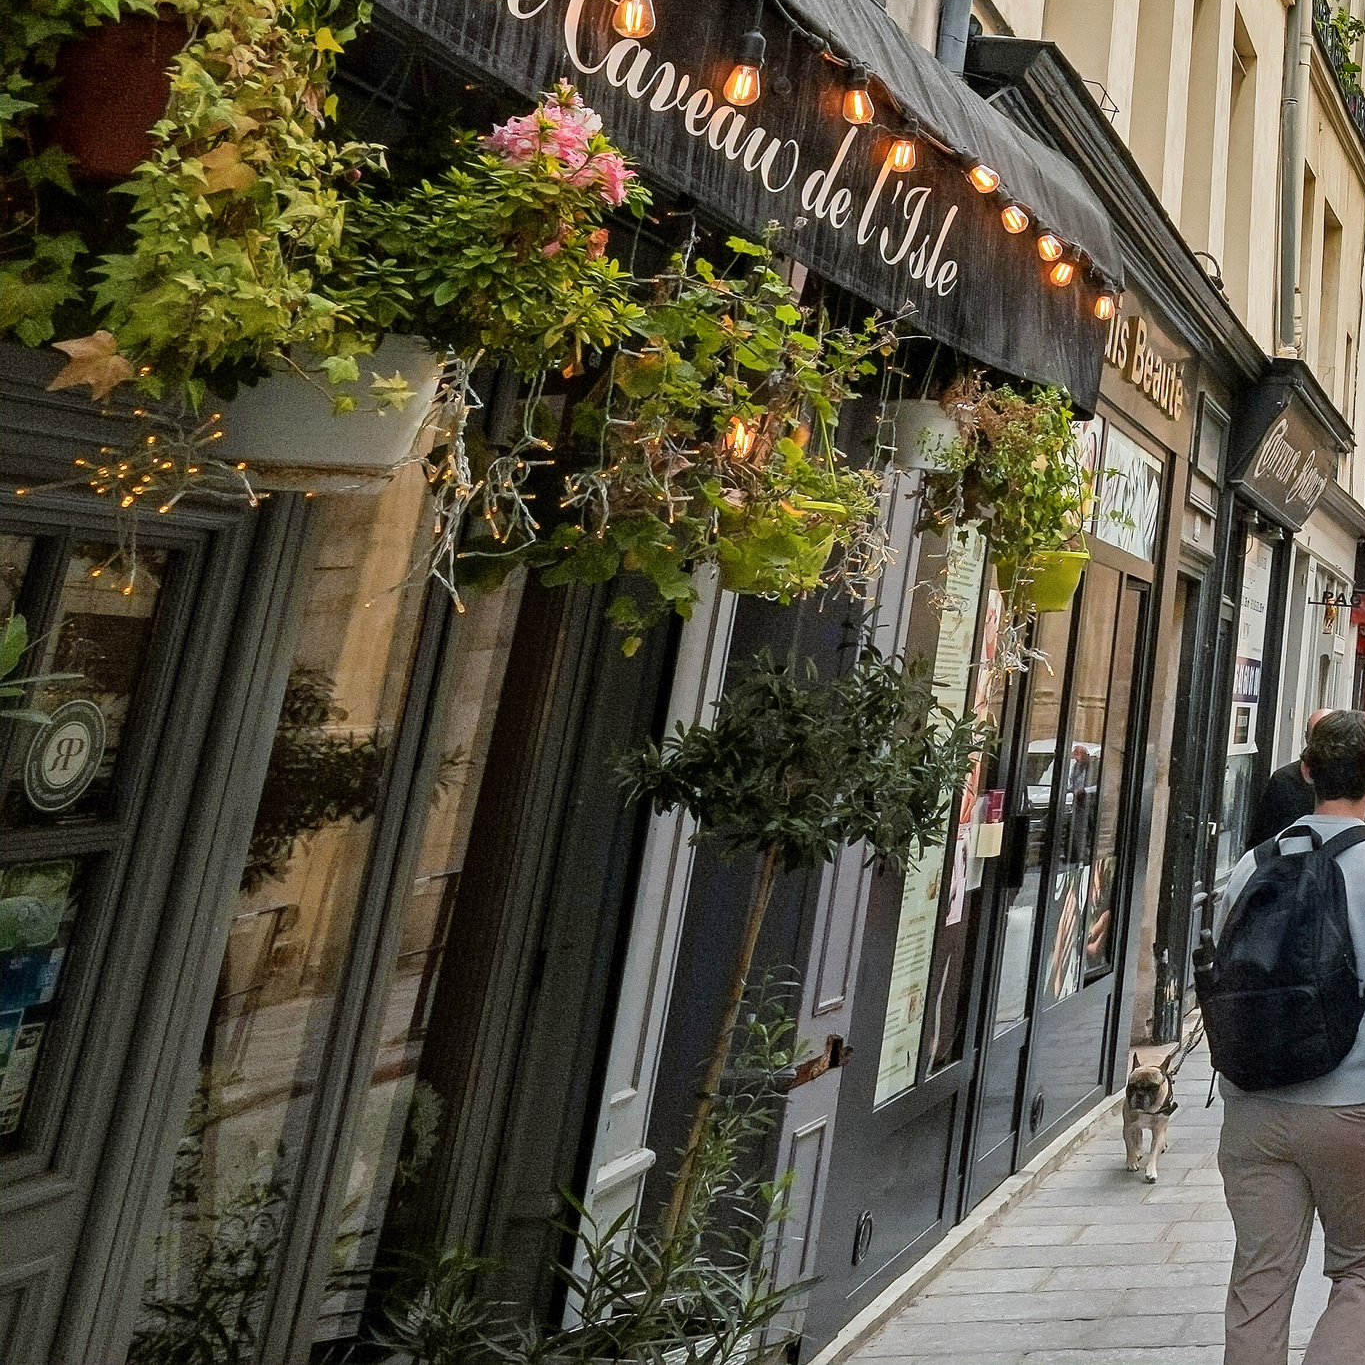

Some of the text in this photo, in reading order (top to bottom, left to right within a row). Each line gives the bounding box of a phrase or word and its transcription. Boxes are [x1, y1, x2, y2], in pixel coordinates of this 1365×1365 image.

[802, 126, 858, 229] de
[857, 158, 959, 297] l'Isle
[1131, 316, 1185, 421] Beauté
